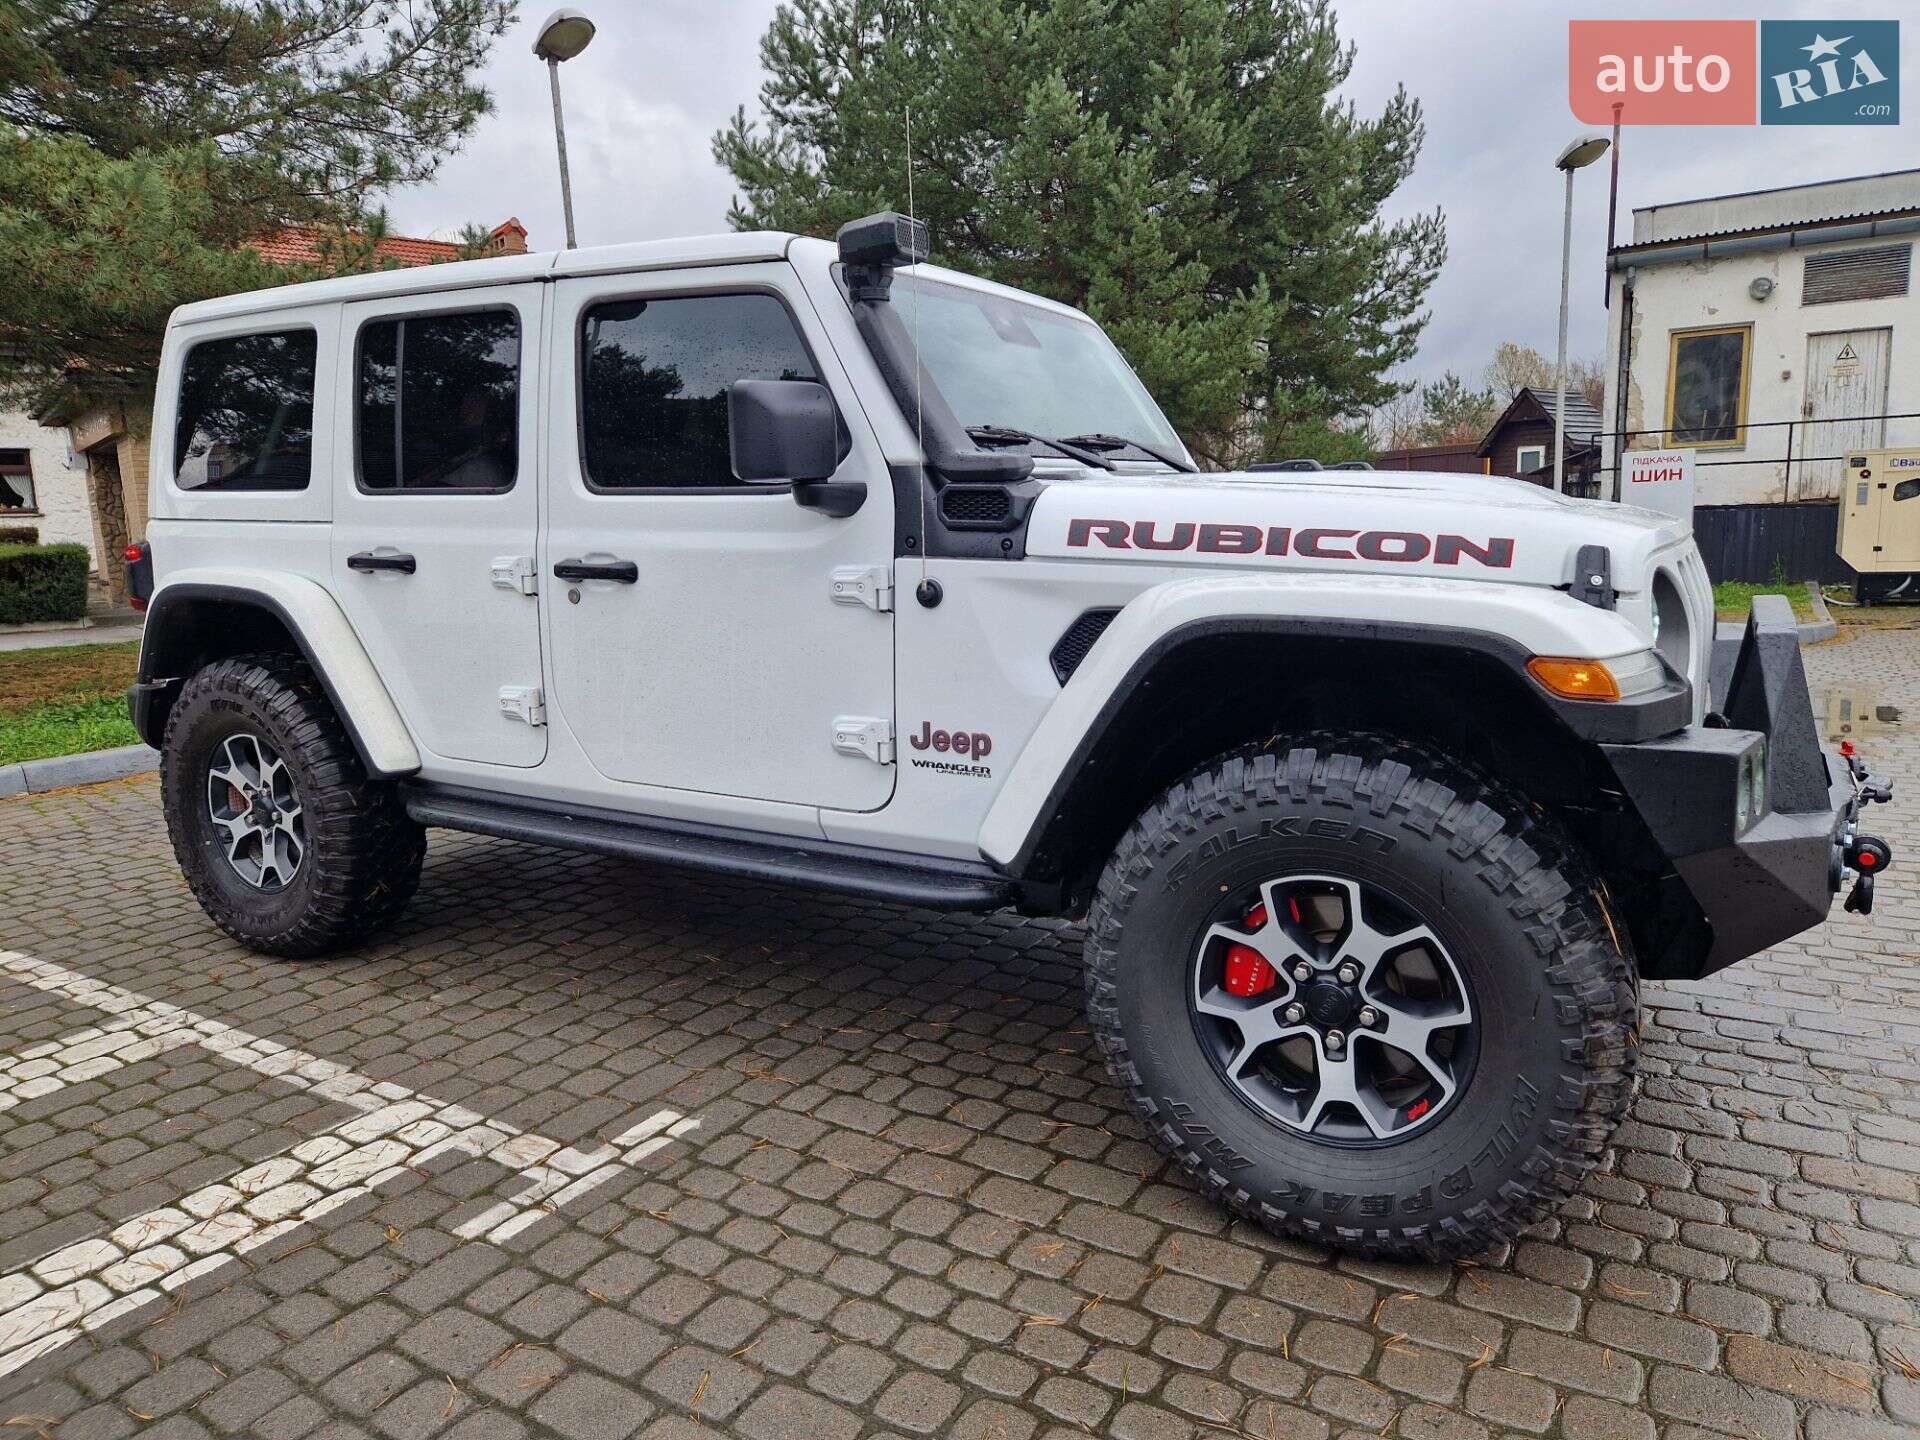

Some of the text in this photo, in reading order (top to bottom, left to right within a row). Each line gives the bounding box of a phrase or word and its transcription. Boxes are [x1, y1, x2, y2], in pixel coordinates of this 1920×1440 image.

[1632, 456, 1683, 465] ПІДКАЧКА
[1632, 468, 1683, 483] ШИН
[1067, 518, 1515, 568] RUBICON
[910, 720, 992, 761] Jeep
[911, 759, 991, 774] WRANGLER
[936, 769, 991, 778] UNLIMITED
[1163, 816, 1398, 893] FALKEN
